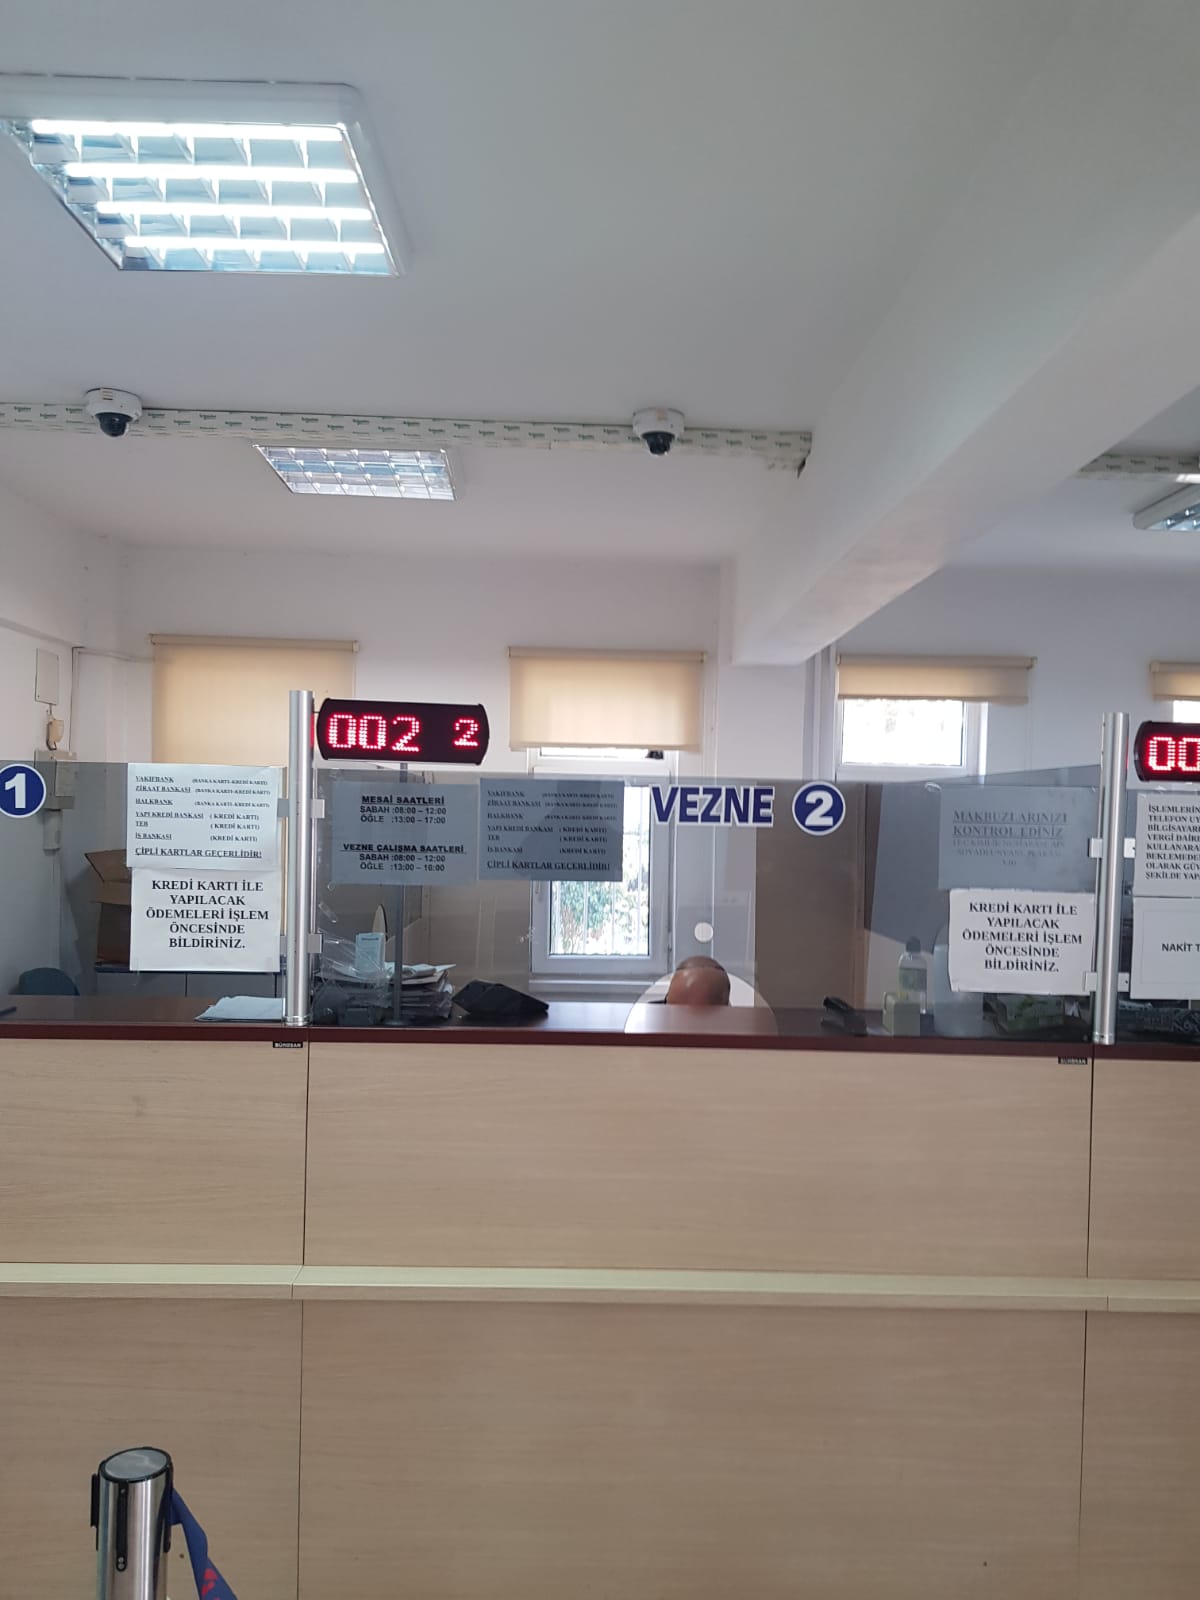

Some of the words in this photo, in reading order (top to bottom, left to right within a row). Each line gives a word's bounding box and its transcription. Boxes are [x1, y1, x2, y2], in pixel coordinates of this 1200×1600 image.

[329, 714, 420, 752] 002
[454, 719, 478, 747] 2
[5, 773, 26, 808] 1
[361, 795, 393, 805] MESAİ
[396, 796, 445, 805] SAATLERİ
[425, 807, 447, 815] 12:00
[651, 786, 774, 823] VEZNE
[805, 790, 834, 826] 2
[360, 814, 384, 823] ÖĞLE
[424, 816, 446, 824] 17:00
[1149, 814, 1187, 823] TELEFON
[953, 825, 1013, 836] KONTROL
[1147, 833, 1174, 842] VERGİ
[135, 846, 159, 857] ÇİPLİ
[160, 848, 203, 857] KARTLAR
[204, 849, 263, 859] GEÇERLİDİR!
[343, 843, 373, 851] VEZNE
[420, 845, 464, 854] SAATLERİ
[360, 853, 390, 861] SABAH
[424, 855, 446, 863] 12:00
[360, 862, 384, 871] ÖĞLE
[512, 861, 553, 870] KARTLAR
[1145, 861, 1181, 870] OLARAK
[1145, 870, 1181, 880] ŞEKİLDE
[152, 878, 193, 890] KREDİ
[197, 881, 237, 891] KARTI
[242, 880, 264, 892] İLE
[170, 894, 246, 905] YAPILACAK
[146, 906, 224, 919] ÖDEMELERİ
[229, 908, 269, 922] İŞLEM
[969, 901, 1009, 914] KREDİ
[1013, 903, 1052, 915] KARTI
[1056, 902, 1078, 916] İLE
[170, 921, 245, 934] ÖNCESİNDE
[987, 916, 1060, 929] YAPILACAK
[962, 928, 1039, 942] ÖDEMELERİ
[1043, 931, 1082, 945] İŞLEM
[169, 936, 246, 949] BİLDİRİNİZ.
[1162, 941, 1192, 952] NAKİT
[985, 943, 1060, 957] ÖNCESİNDE
[984, 957, 1060, 972] BİLDİRİNİZ.
